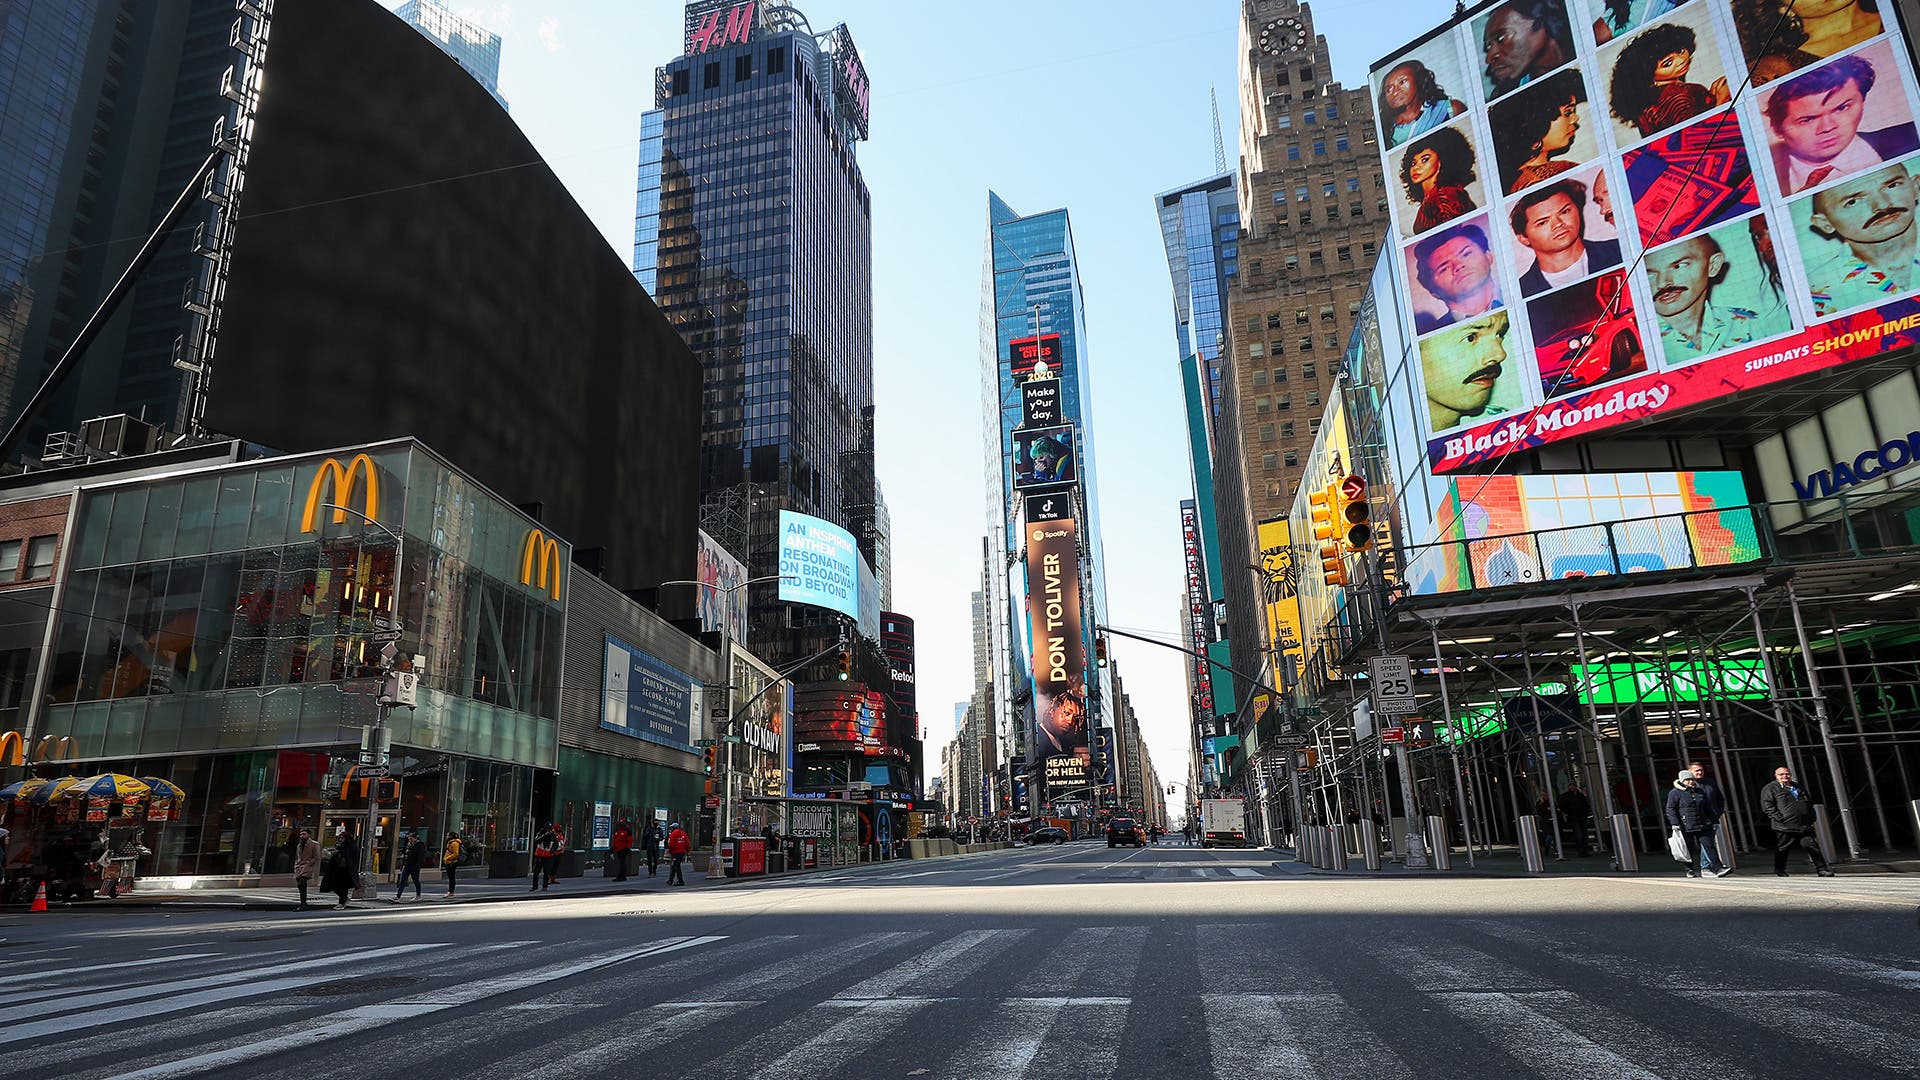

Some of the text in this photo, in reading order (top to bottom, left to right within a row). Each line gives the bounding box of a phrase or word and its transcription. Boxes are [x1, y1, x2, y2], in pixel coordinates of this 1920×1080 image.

[689, 2, 755, 54] H&M
[1744, 314, 1920, 373] SUNDAYS SHOWTIME
[1023, 347, 1052, 359] CITES
[1028, 371, 1053, 382] 2020
[1027, 388, 1055, 398] Make
[1030, 399, 1053, 411] your
[1032, 411, 1053, 420] day.
[1444, 384, 1669, 460] Black Monday
[788, 523, 854, 556] AN INSPIRING
[1045, 530, 1068, 538] Spotify
[786, 535, 836, 557] ANTHEM
[783, 548, 851, 577] RESONATING
[780, 561, 855, 591] ON BROADWAY
[805, 578, 848, 600] BEYOND.
[1043, 553, 1067, 682] DON TOLIVER
[1281, 627, 1293, 636] HE
[1380, 679, 1409, 696] 25
[744, 720, 779, 754] OLD NAVY
[1046, 757, 1083, 767] HEAVEN
[1045, 766, 1085, 777] OR HELL
[793, 805, 832, 813] DISCOVER
[792, 812, 832, 830] BROADWAY'S
[792, 829, 832, 838] SECRETS
